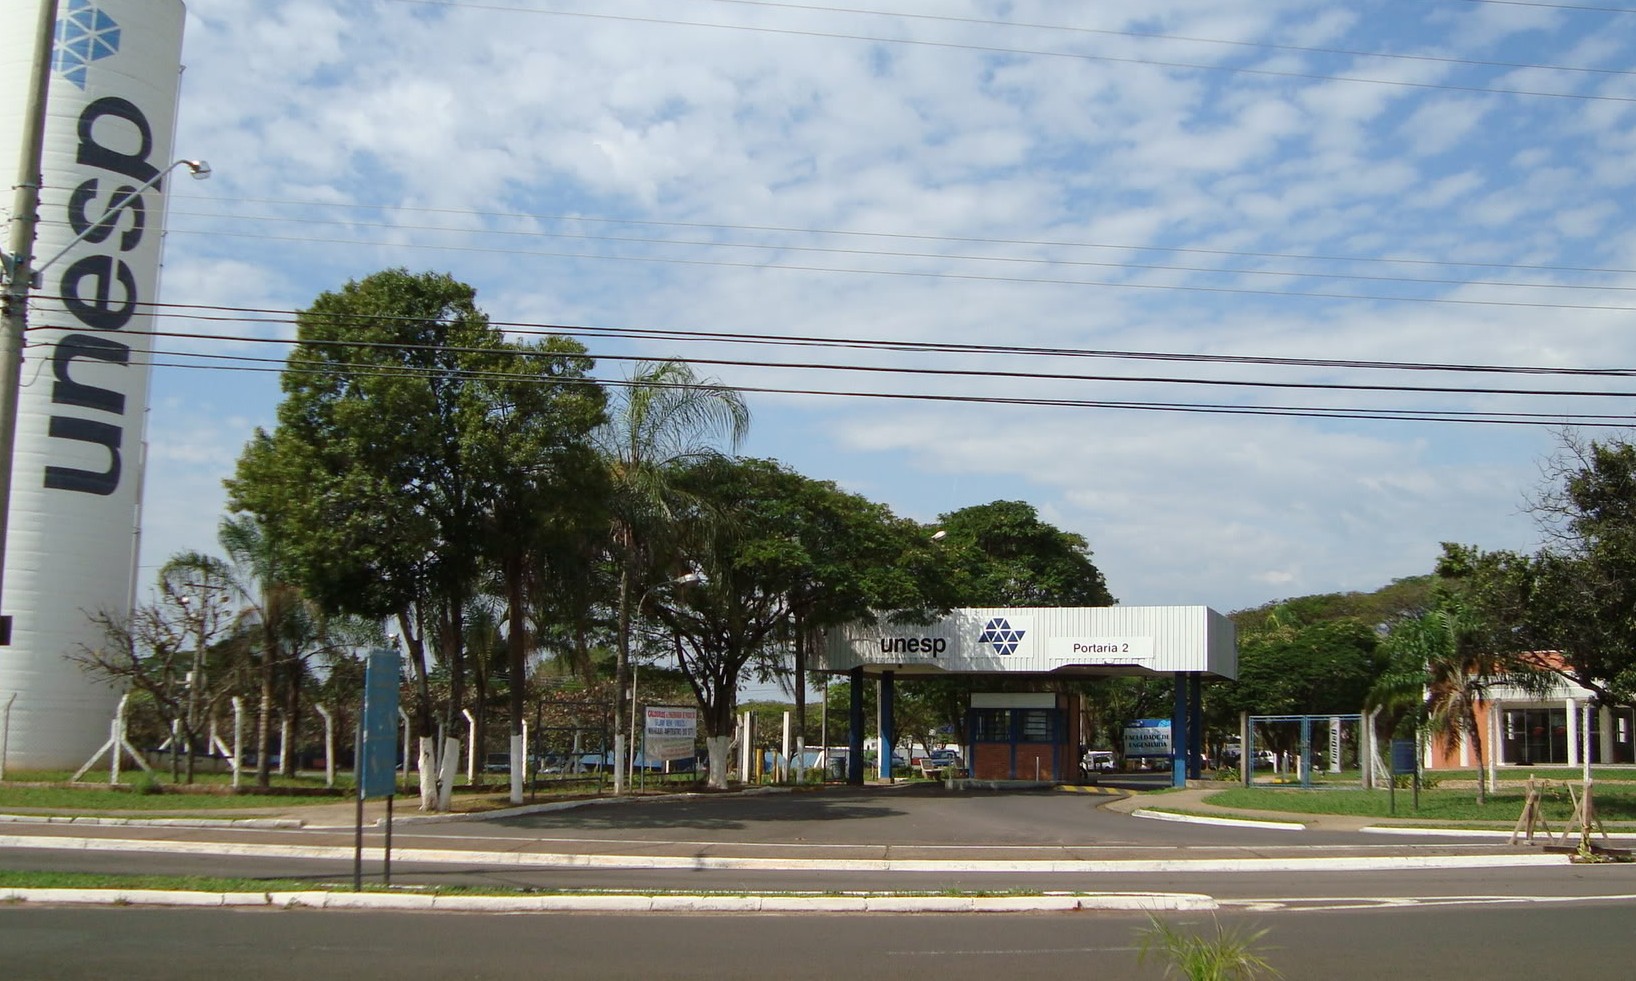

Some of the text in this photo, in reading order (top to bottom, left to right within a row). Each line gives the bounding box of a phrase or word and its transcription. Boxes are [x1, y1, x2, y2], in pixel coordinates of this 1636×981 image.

[43, 96, 162, 497] unesp
[880, 637, 947, 657] unesp
[1073, 642, 1129, 654] Portaria 2
